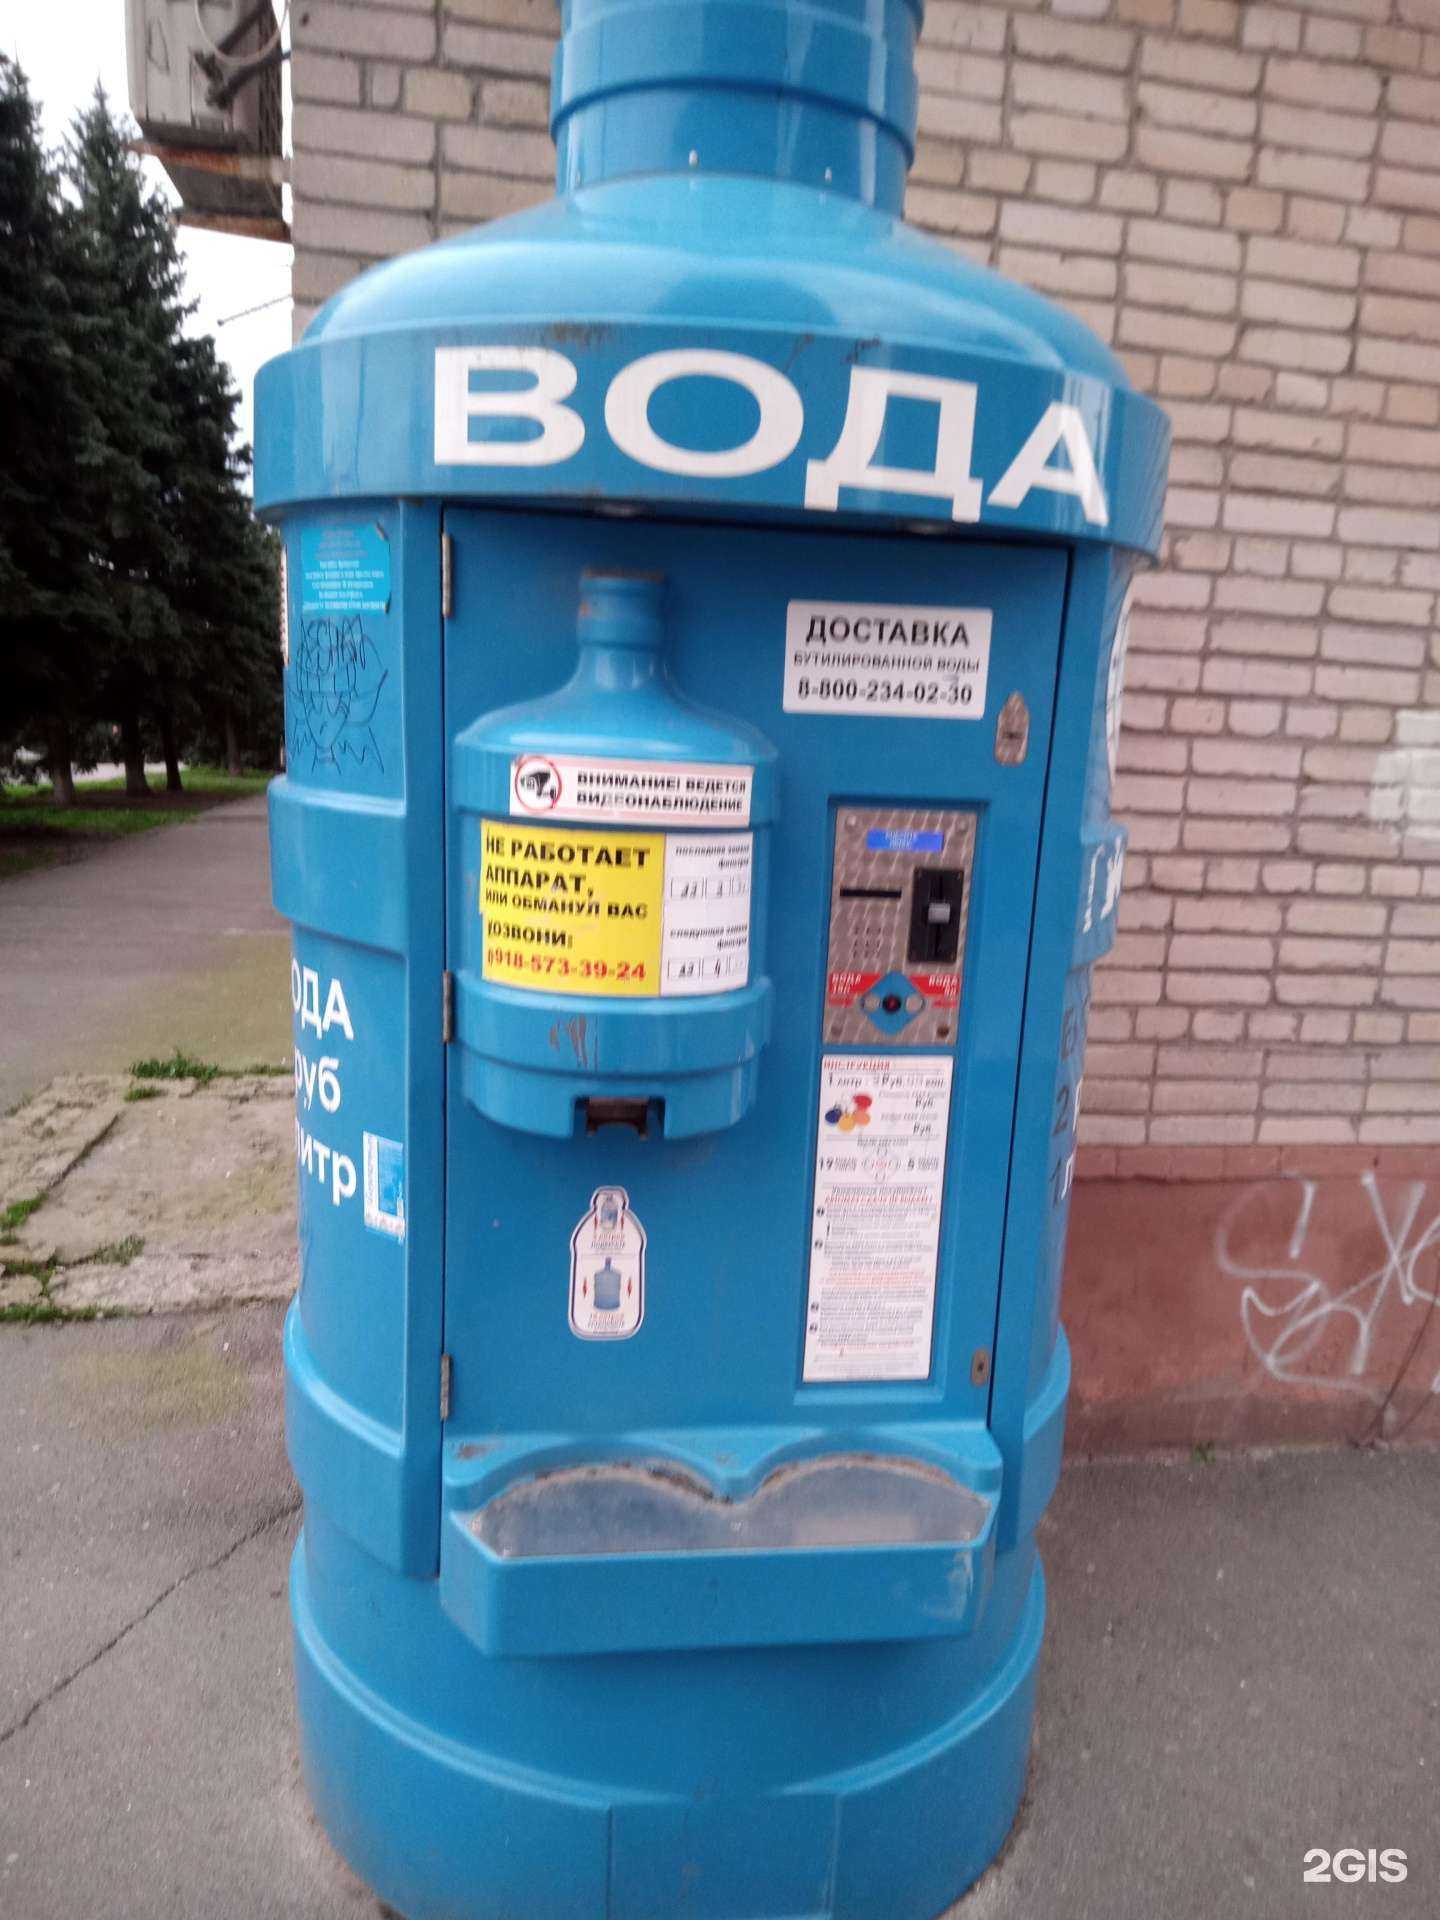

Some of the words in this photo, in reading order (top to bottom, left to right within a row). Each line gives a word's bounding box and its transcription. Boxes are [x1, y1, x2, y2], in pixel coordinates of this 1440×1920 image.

[435, 347, 1108, 526] ВОДА
[805, 614, 969, 646] ДОСТАВКА
[797, 676, 973, 705] 8-800-234-02-30
[577, 770, 681, 789] ВНИМАНИЕ!
[576, 790, 743, 812] ВИДЕОНАБЛЮДЕНИЕ
[486, 832, 505, 856] НЕ
[511, 839, 651, 869] РАБОТАЕТ
[486, 864, 595, 898] АППАРАТ,
[512, 892, 600, 919] ОБМАНУЛ
[607, 901, 648, 919] ВАС
[294, 1044, 342, 1113] руб
